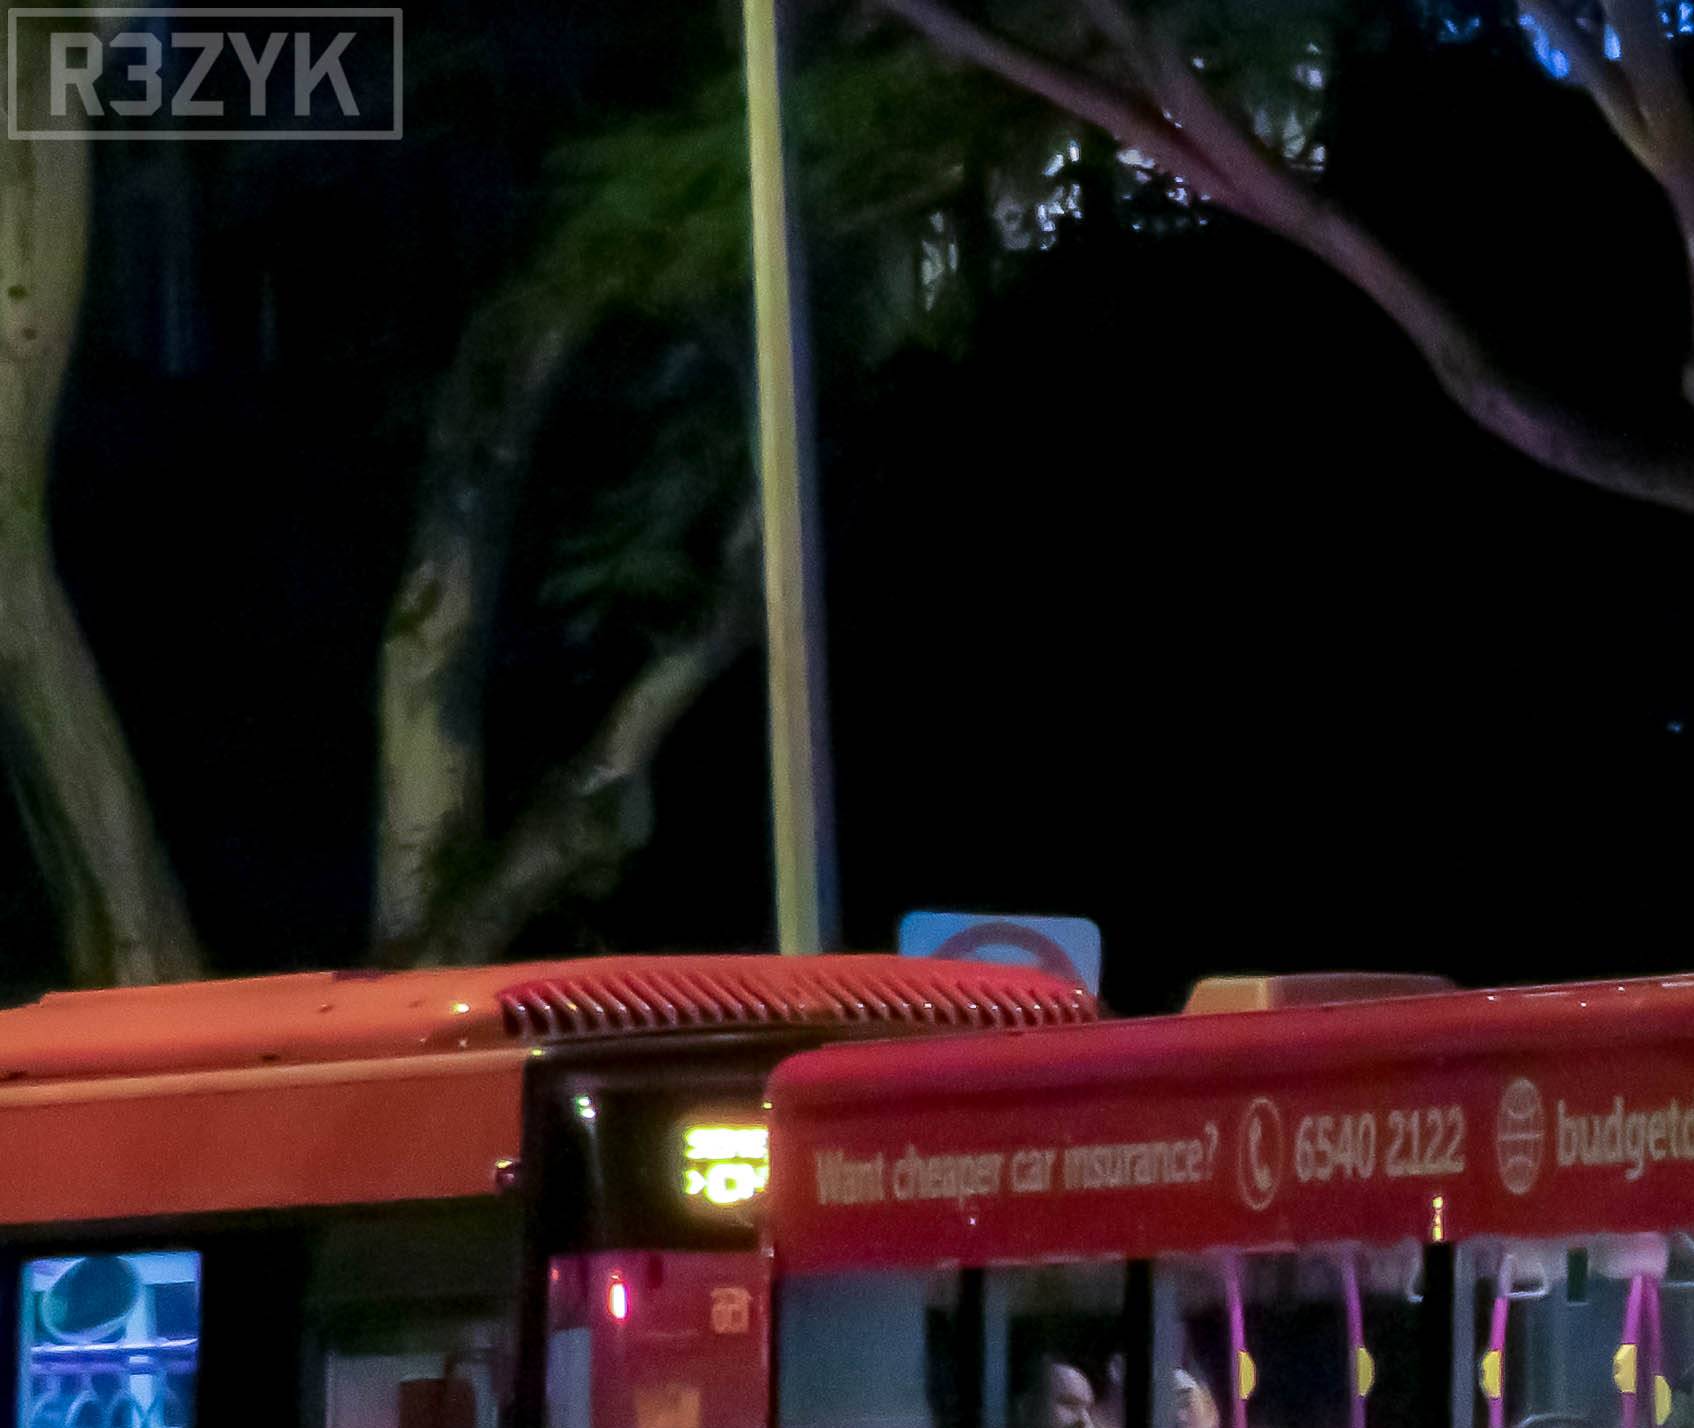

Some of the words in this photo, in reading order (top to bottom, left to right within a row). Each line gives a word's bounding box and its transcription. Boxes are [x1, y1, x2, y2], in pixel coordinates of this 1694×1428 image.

[892, 1143, 1004, 1211] cheaper
[1010, 1147, 1056, 1193] car
[1063, 1121, 1220, 1190] insurance?
[1294, 1111, 1377, 1182] 6540
[1386, 1105, 1466, 1178] 2122
